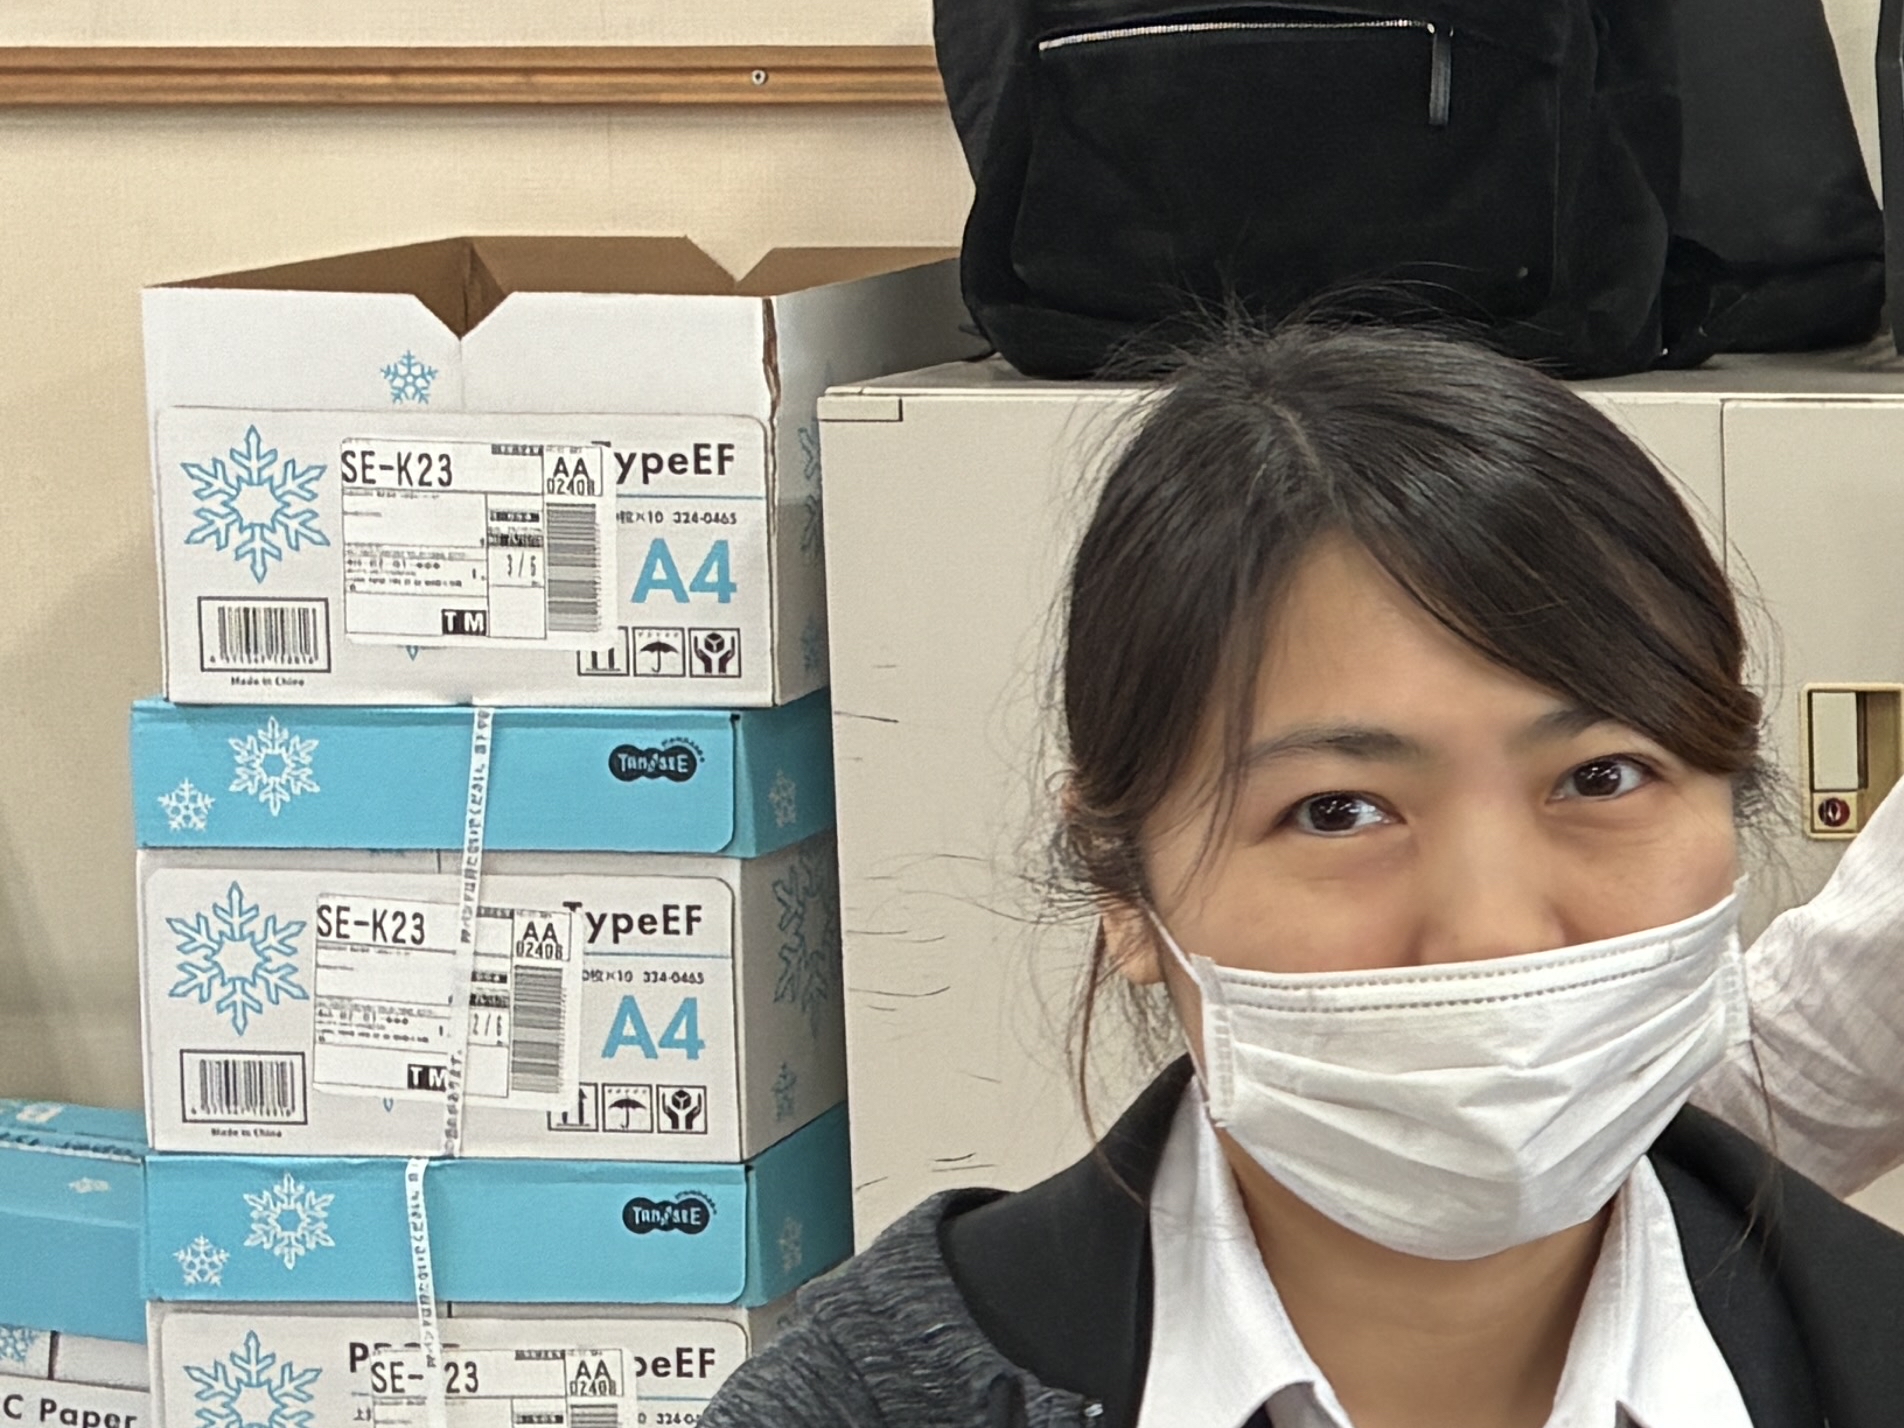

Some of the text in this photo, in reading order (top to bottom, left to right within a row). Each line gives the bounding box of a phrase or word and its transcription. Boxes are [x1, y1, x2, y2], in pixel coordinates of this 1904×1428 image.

[341, 449, 454, 488] SE-K23
[553, 456, 590, 478] AA
[630, 537, 738, 605] A4
[231, 676, 259, 686] Made
[275, 676, 305, 687] China
[315, 904, 427, 946] SE-K23
[522, 921, 559, 941] AA
[601, 994, 707, 1060] A4
[575, 1359, 611, 1379] AA
